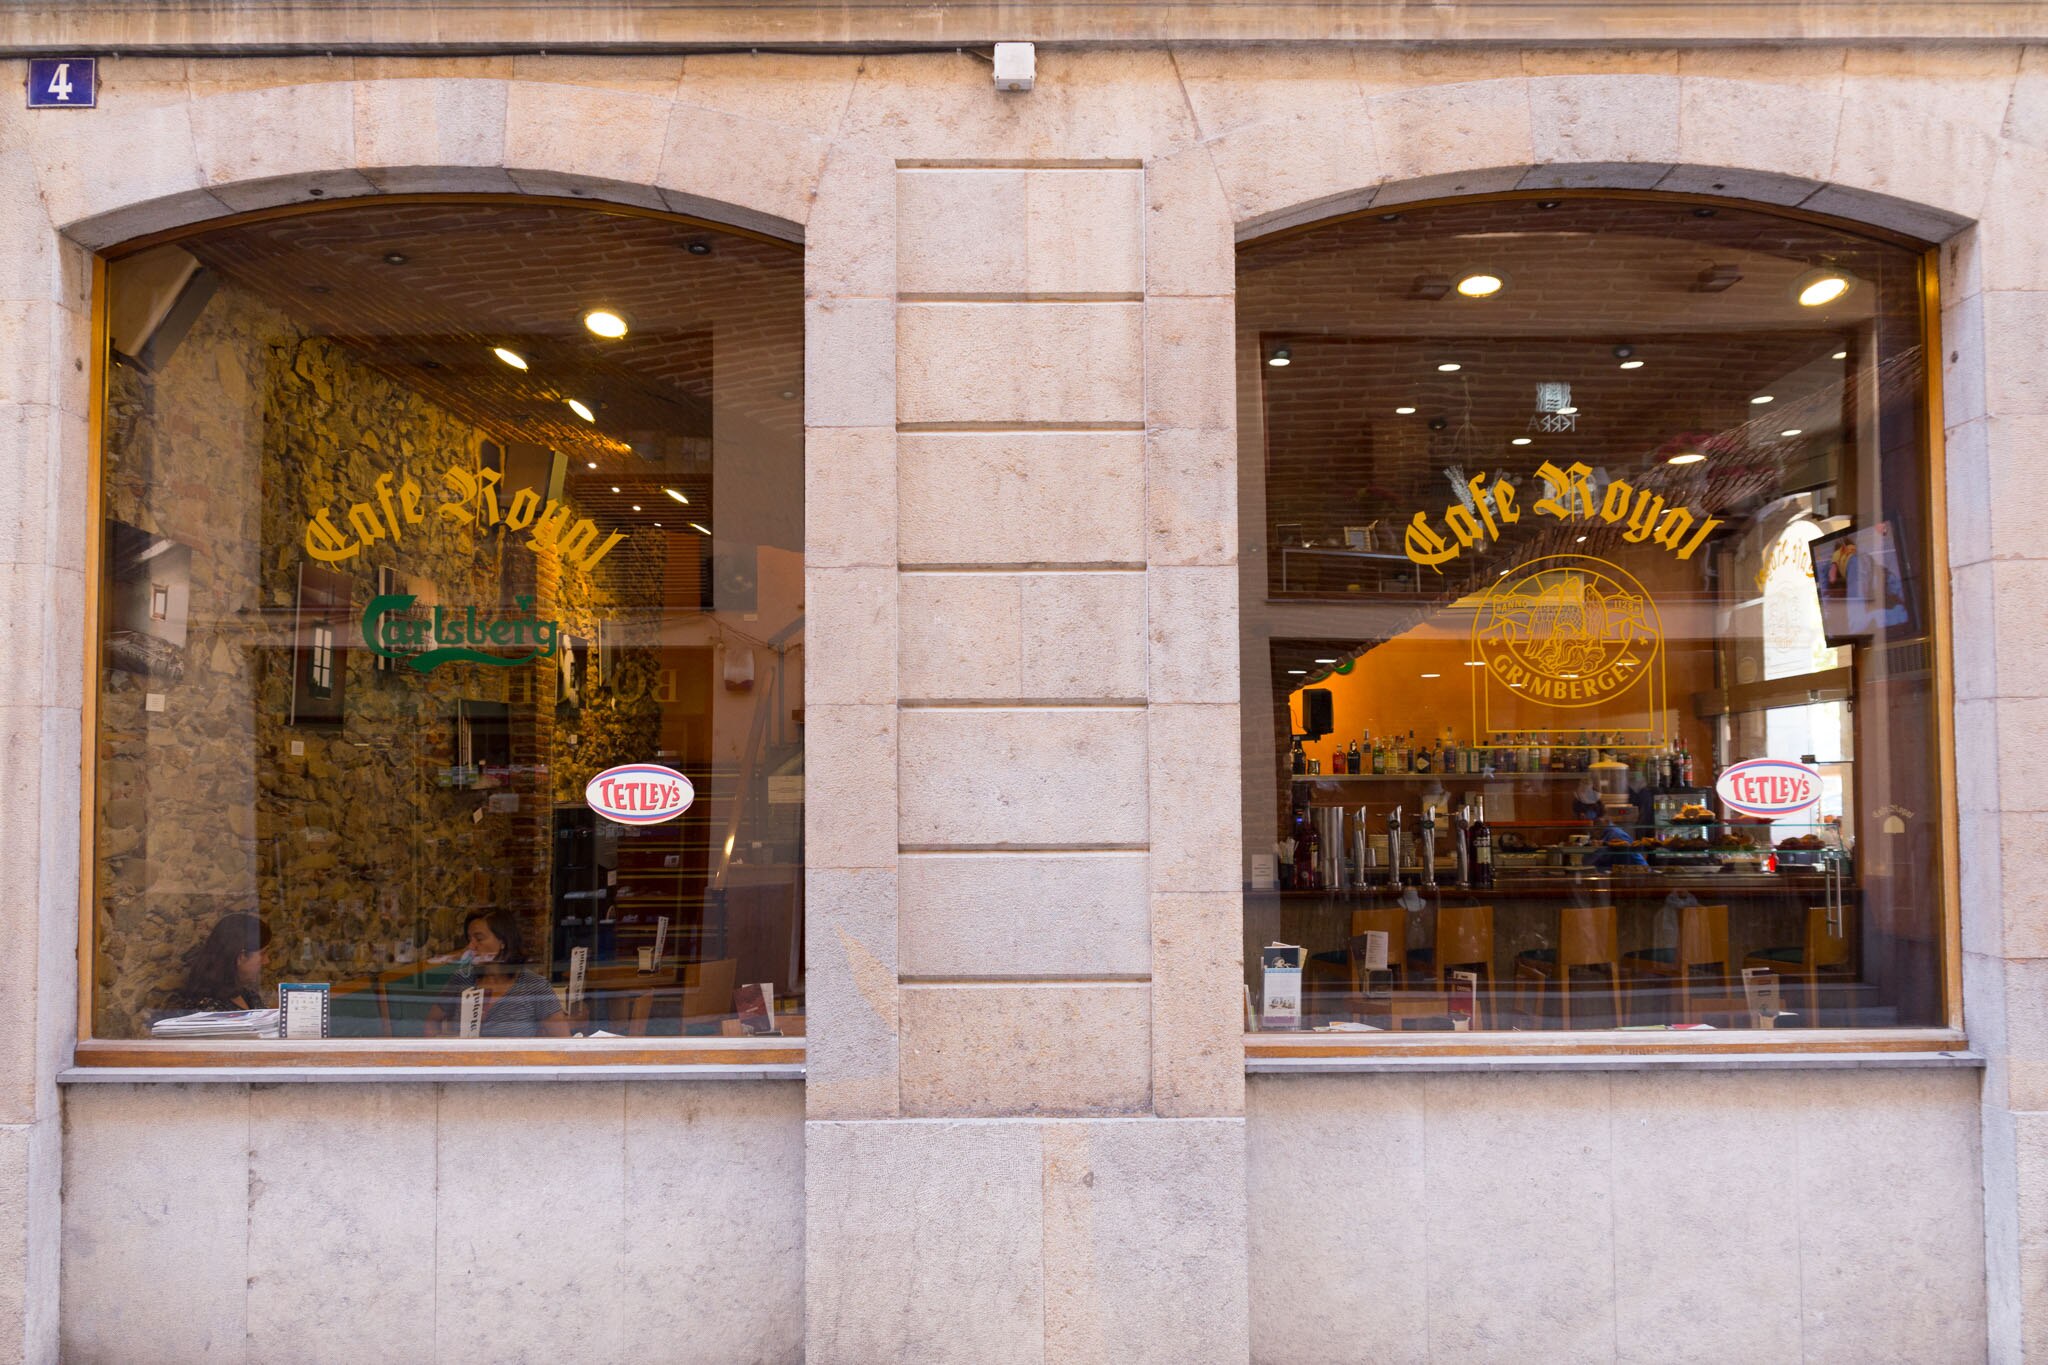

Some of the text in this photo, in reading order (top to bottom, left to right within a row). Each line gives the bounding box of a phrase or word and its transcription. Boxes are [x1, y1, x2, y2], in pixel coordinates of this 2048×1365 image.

[47, 63, 73, 100] 4
[305, 465, 629, 572] Cafe Royal
[1405, 471, 1520, 574] Cafe
[1533, 460, 1725, 560] Royal
[362, 594, 559, 674] Carlsberg
[1493, 650, 1642, 699] GRIMBERGEN
